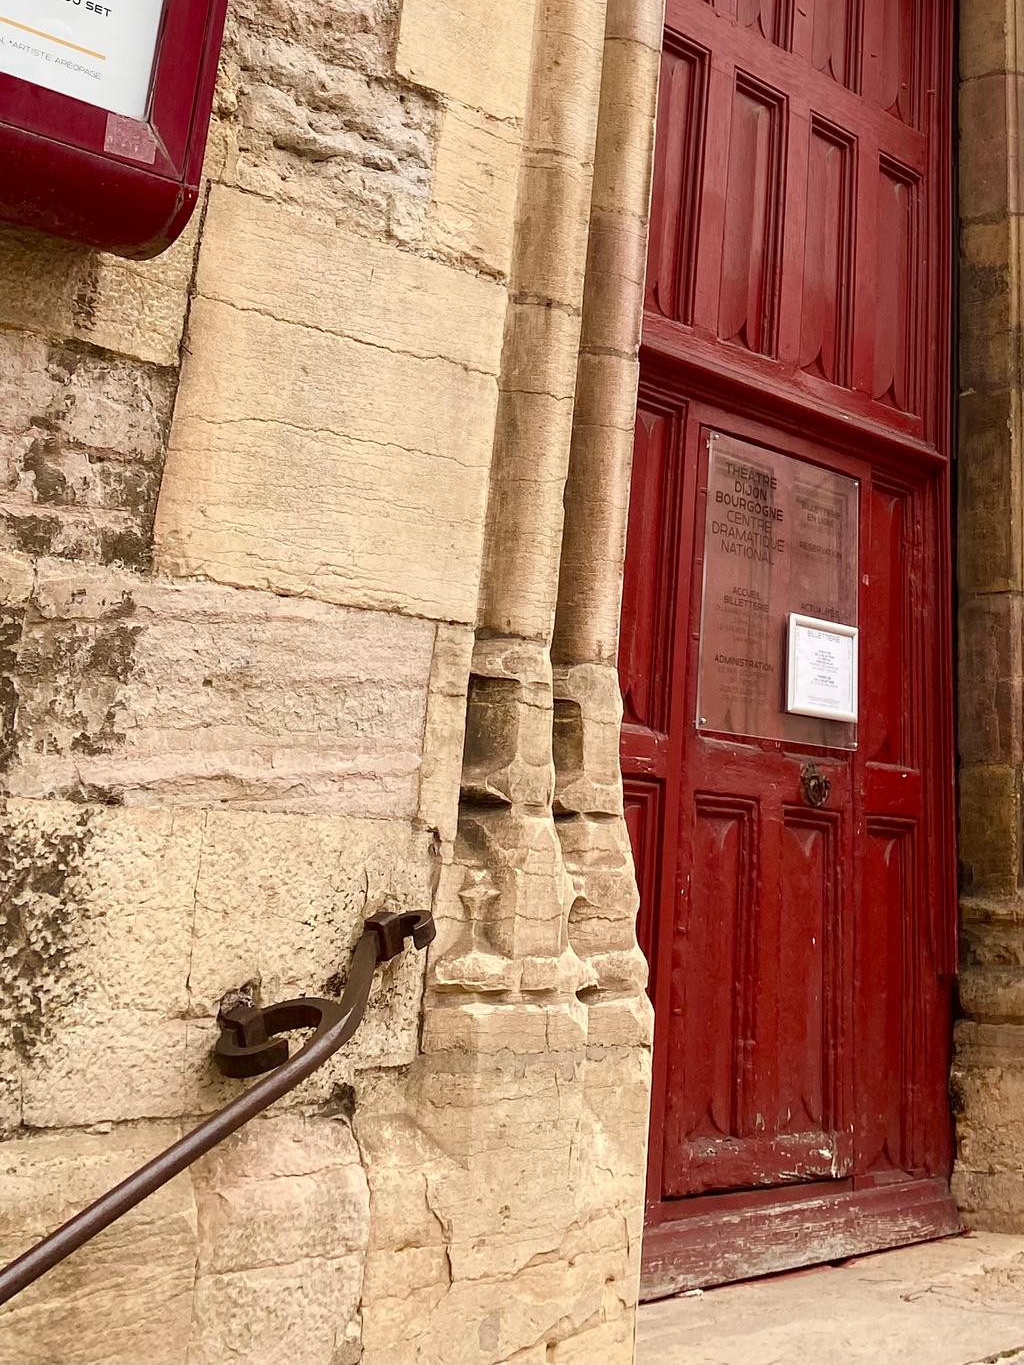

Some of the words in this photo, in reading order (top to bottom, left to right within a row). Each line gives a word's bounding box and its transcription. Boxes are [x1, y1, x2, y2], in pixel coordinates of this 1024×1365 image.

[85, 0, 112, 18] SET
[725, 461, 777, 490] THÉÂTRE
[735, 481, 767, 501] DIJON
[715, 490, 784, 522] BOURGOGNE
[727, 510, 772, 534] CENTRE
[711, 521, 785, 553] DRAMATIQUE
[721, 539, 775, 565] NATIONAL
[723, 594, 769, 613] BILLETTERIE
[714, 653, 774, 673] ADMINISTRATION
